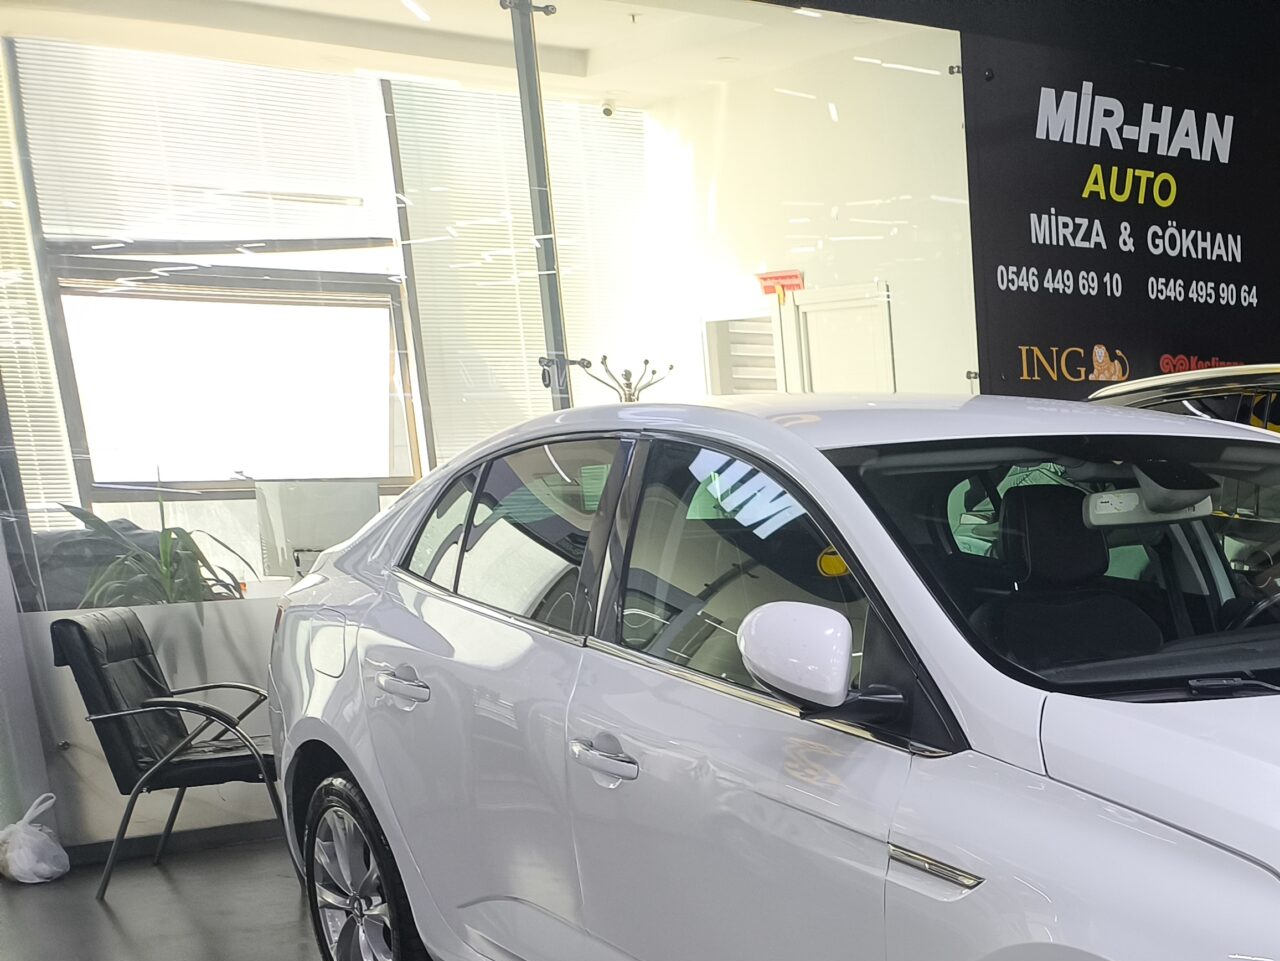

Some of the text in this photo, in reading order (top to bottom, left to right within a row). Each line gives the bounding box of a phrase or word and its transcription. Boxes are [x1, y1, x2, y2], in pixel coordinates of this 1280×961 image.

[1035, 81, 1234, 163] MİR-HAN
[1082, 164, 1177, 208] AUTO
[1030, 208, 1242, 263] MİRZA & GÖKHAN
[997, 265, 1122, 297] 0546 449 69 10
[1148, 277, 1258, 307] 0546 495 90 64
[1018, 346, 1087, 381] ING
